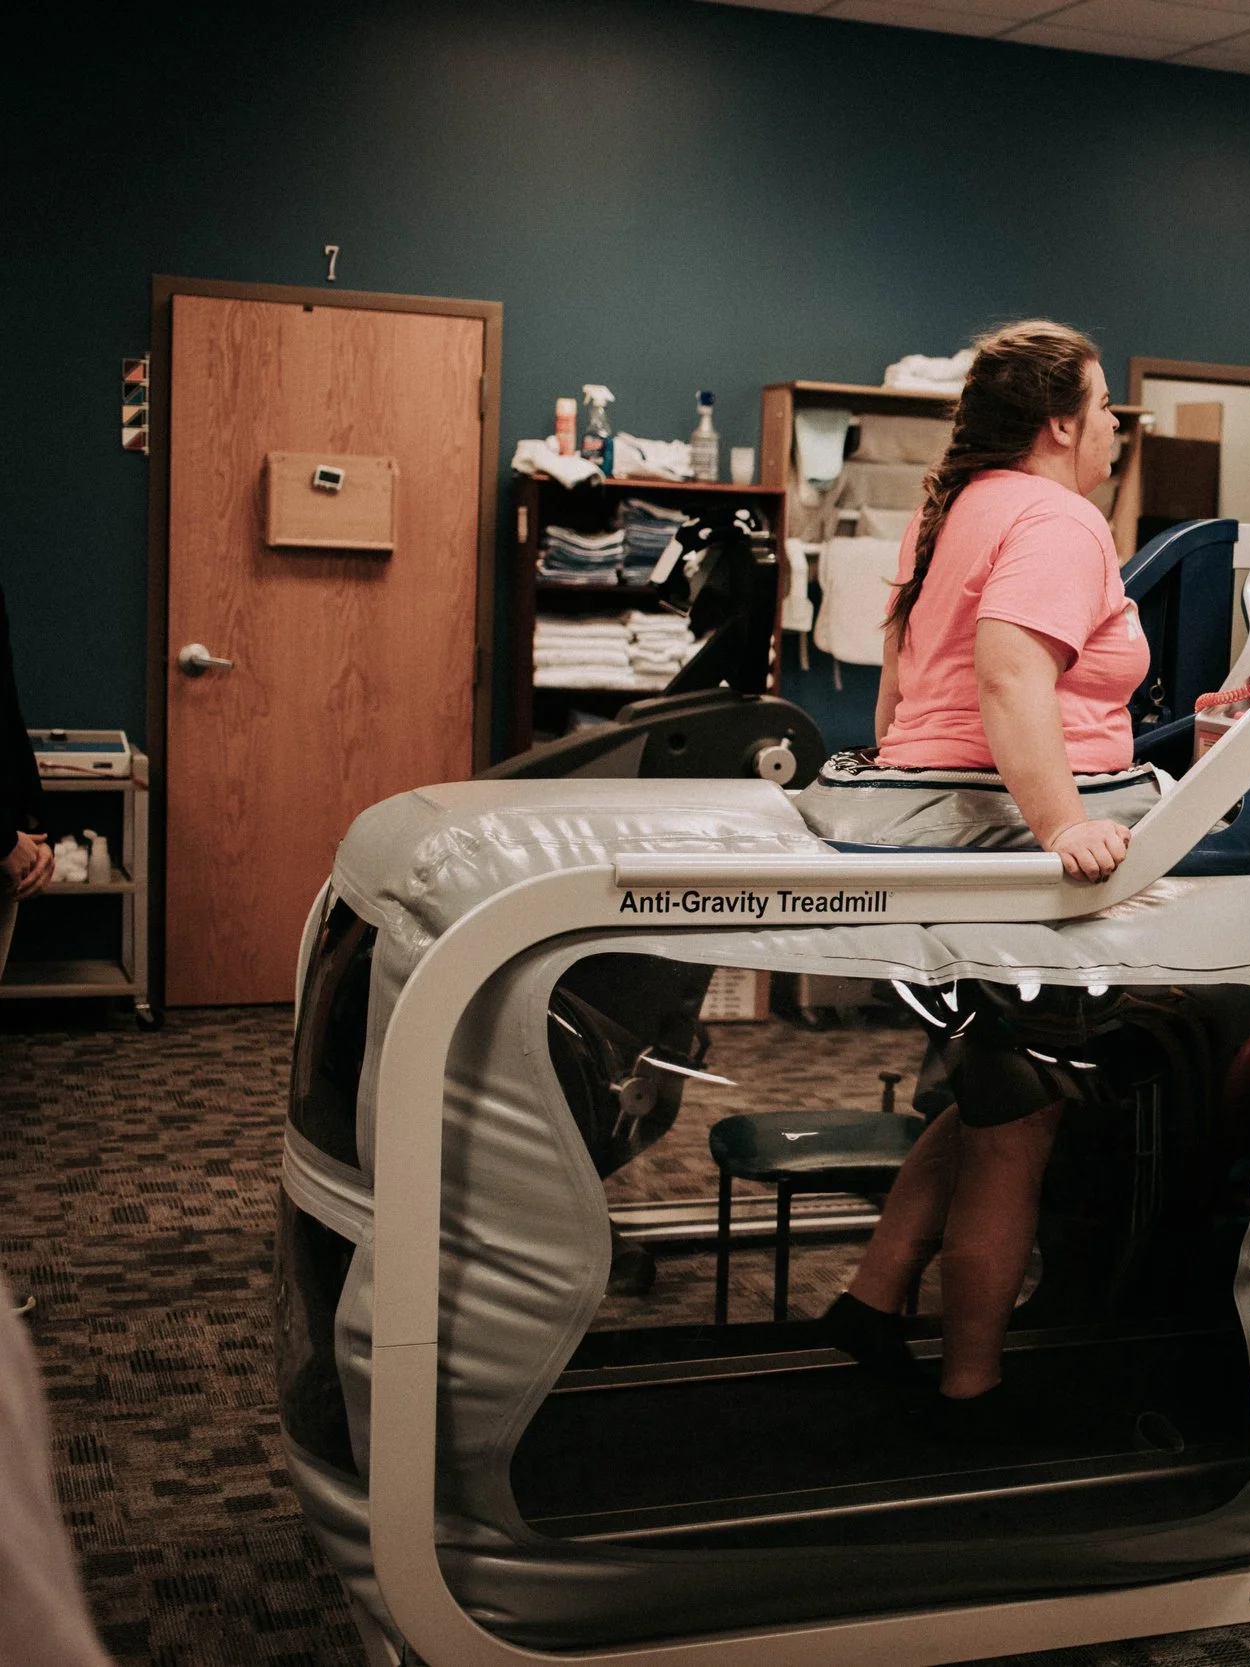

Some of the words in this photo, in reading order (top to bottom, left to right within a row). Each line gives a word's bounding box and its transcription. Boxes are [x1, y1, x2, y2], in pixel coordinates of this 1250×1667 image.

[325, 245, 340, 281] 7
[620, 890, 768, 918] Anti-Gravity
[777, 890, 887, 913] Treadmill
